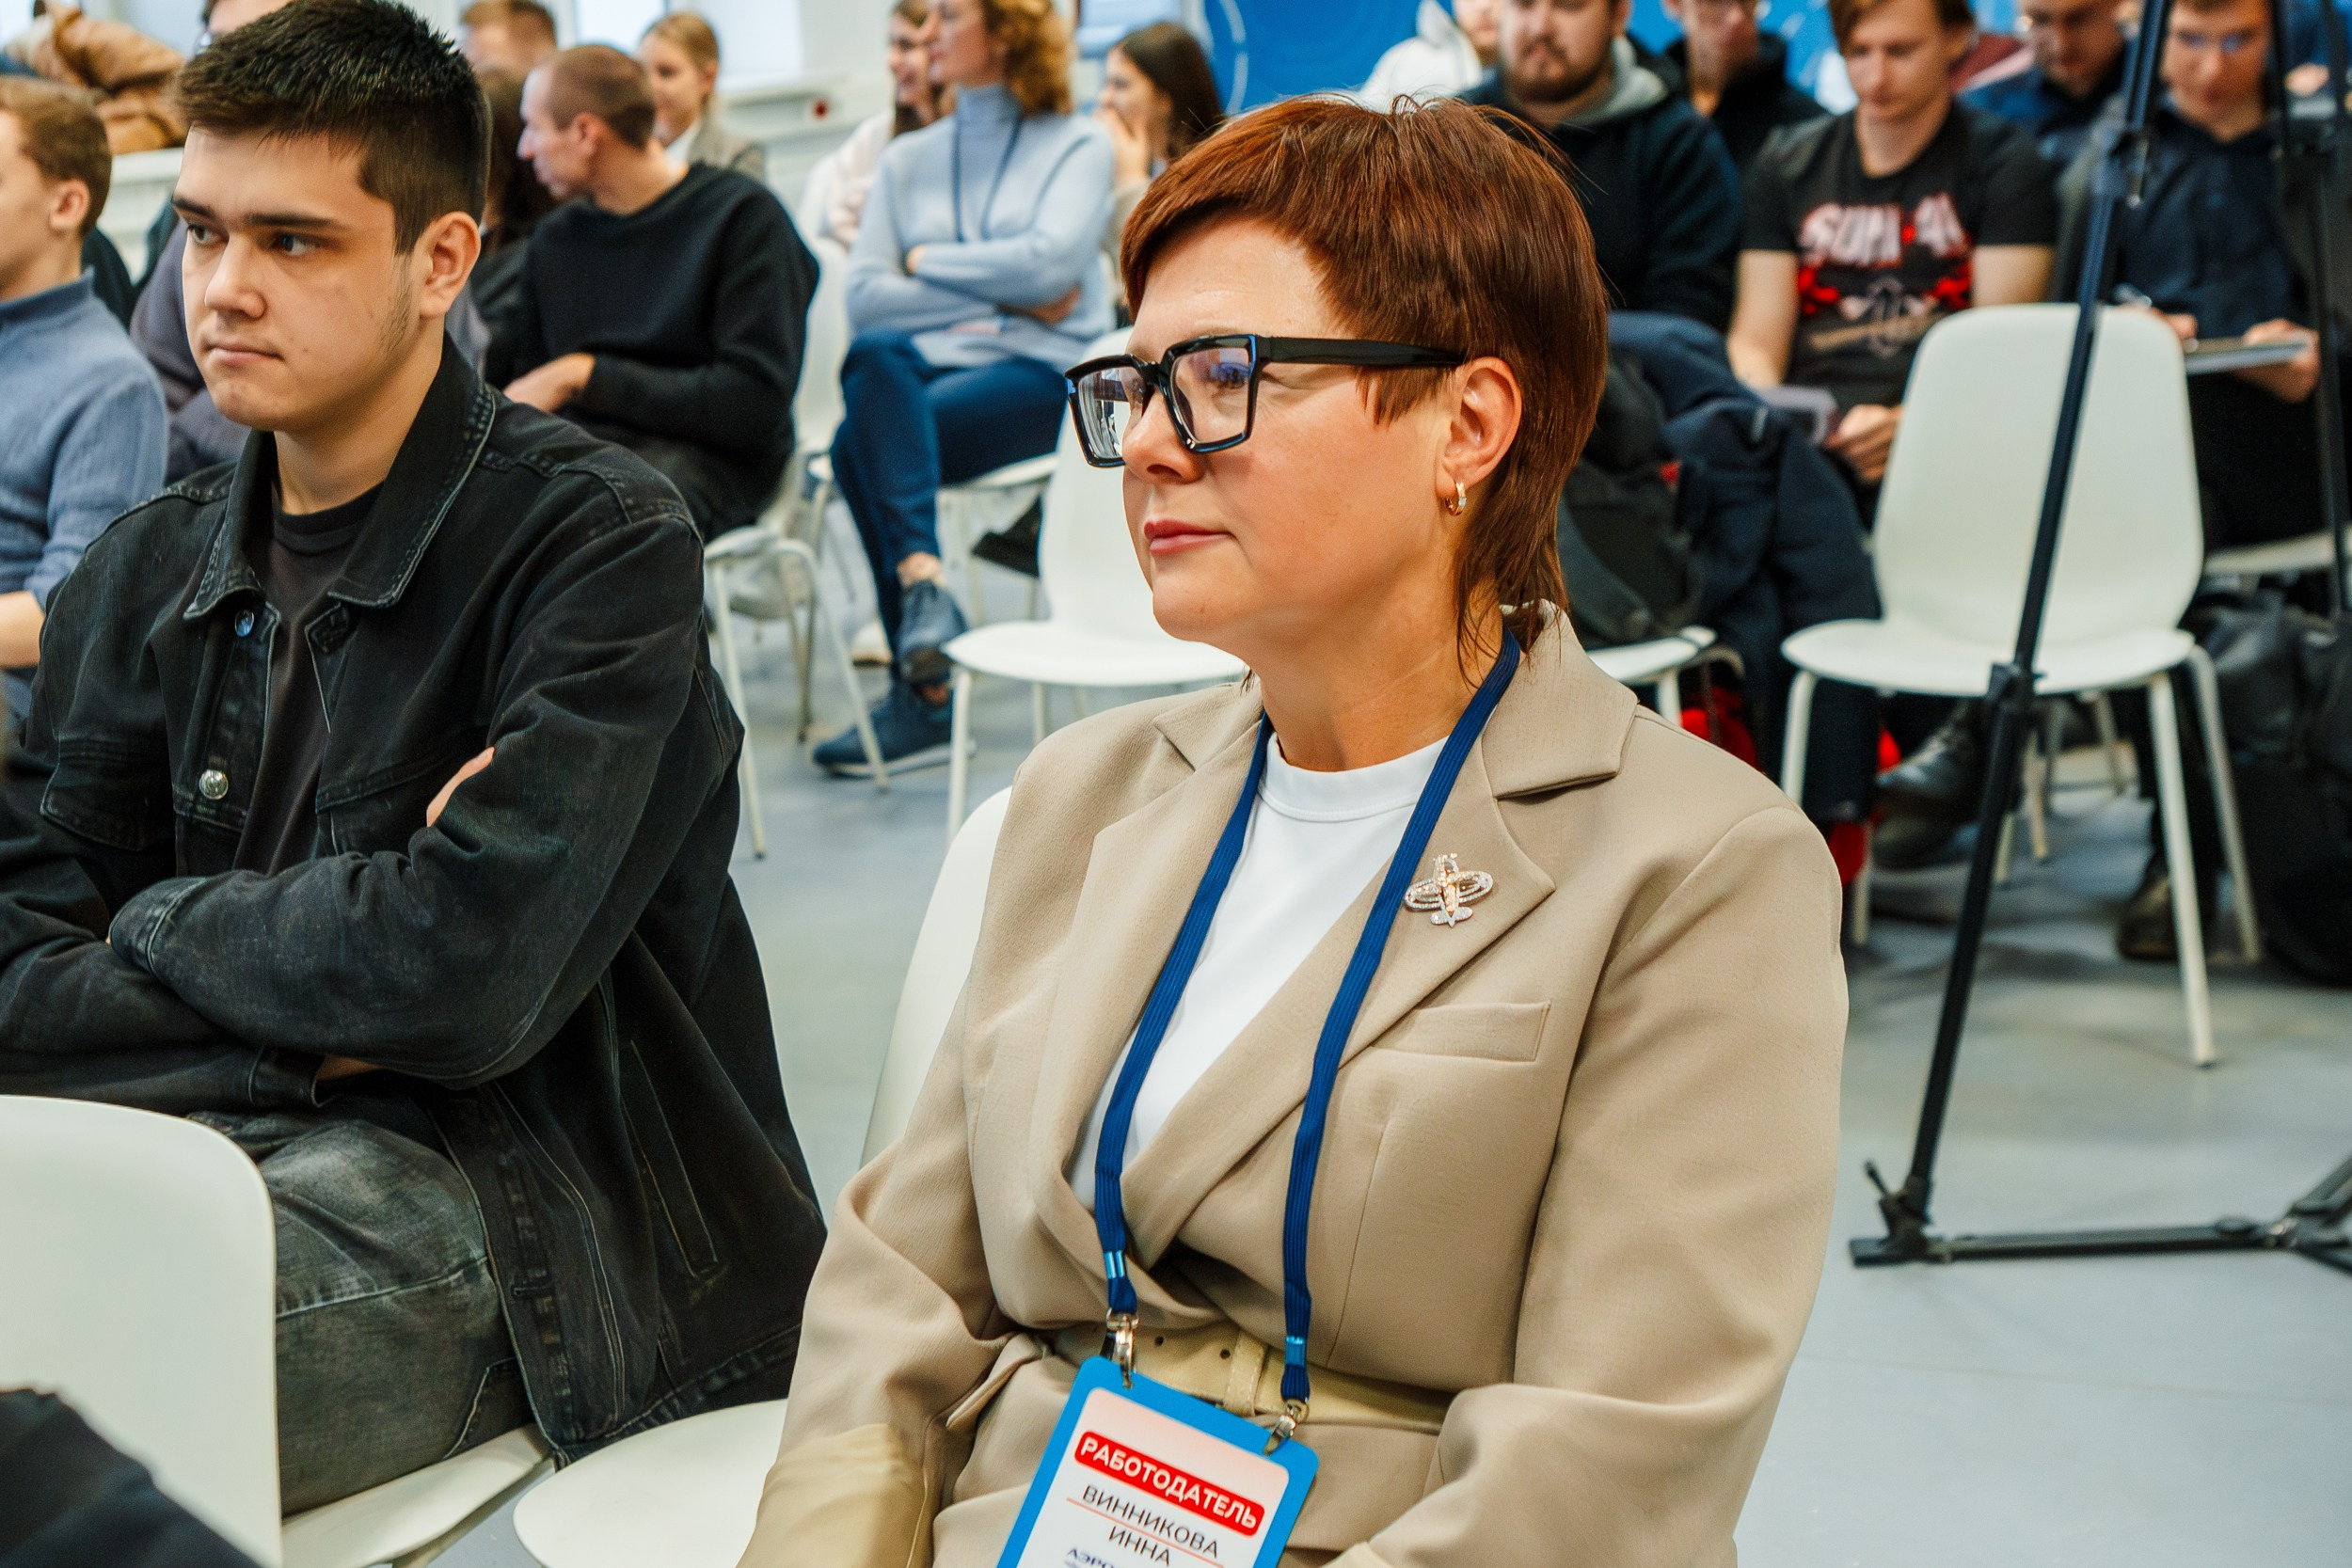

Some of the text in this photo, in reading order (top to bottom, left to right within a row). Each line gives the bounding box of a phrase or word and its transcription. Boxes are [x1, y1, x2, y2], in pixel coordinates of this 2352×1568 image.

[1080, 1436, 1258, 1529] РАБОТОДАТЕЛЬ
[1082, 1484, 1219, 1559] ВИННИКОВА
[1108, 1525, 1170, 1566] ИННА
